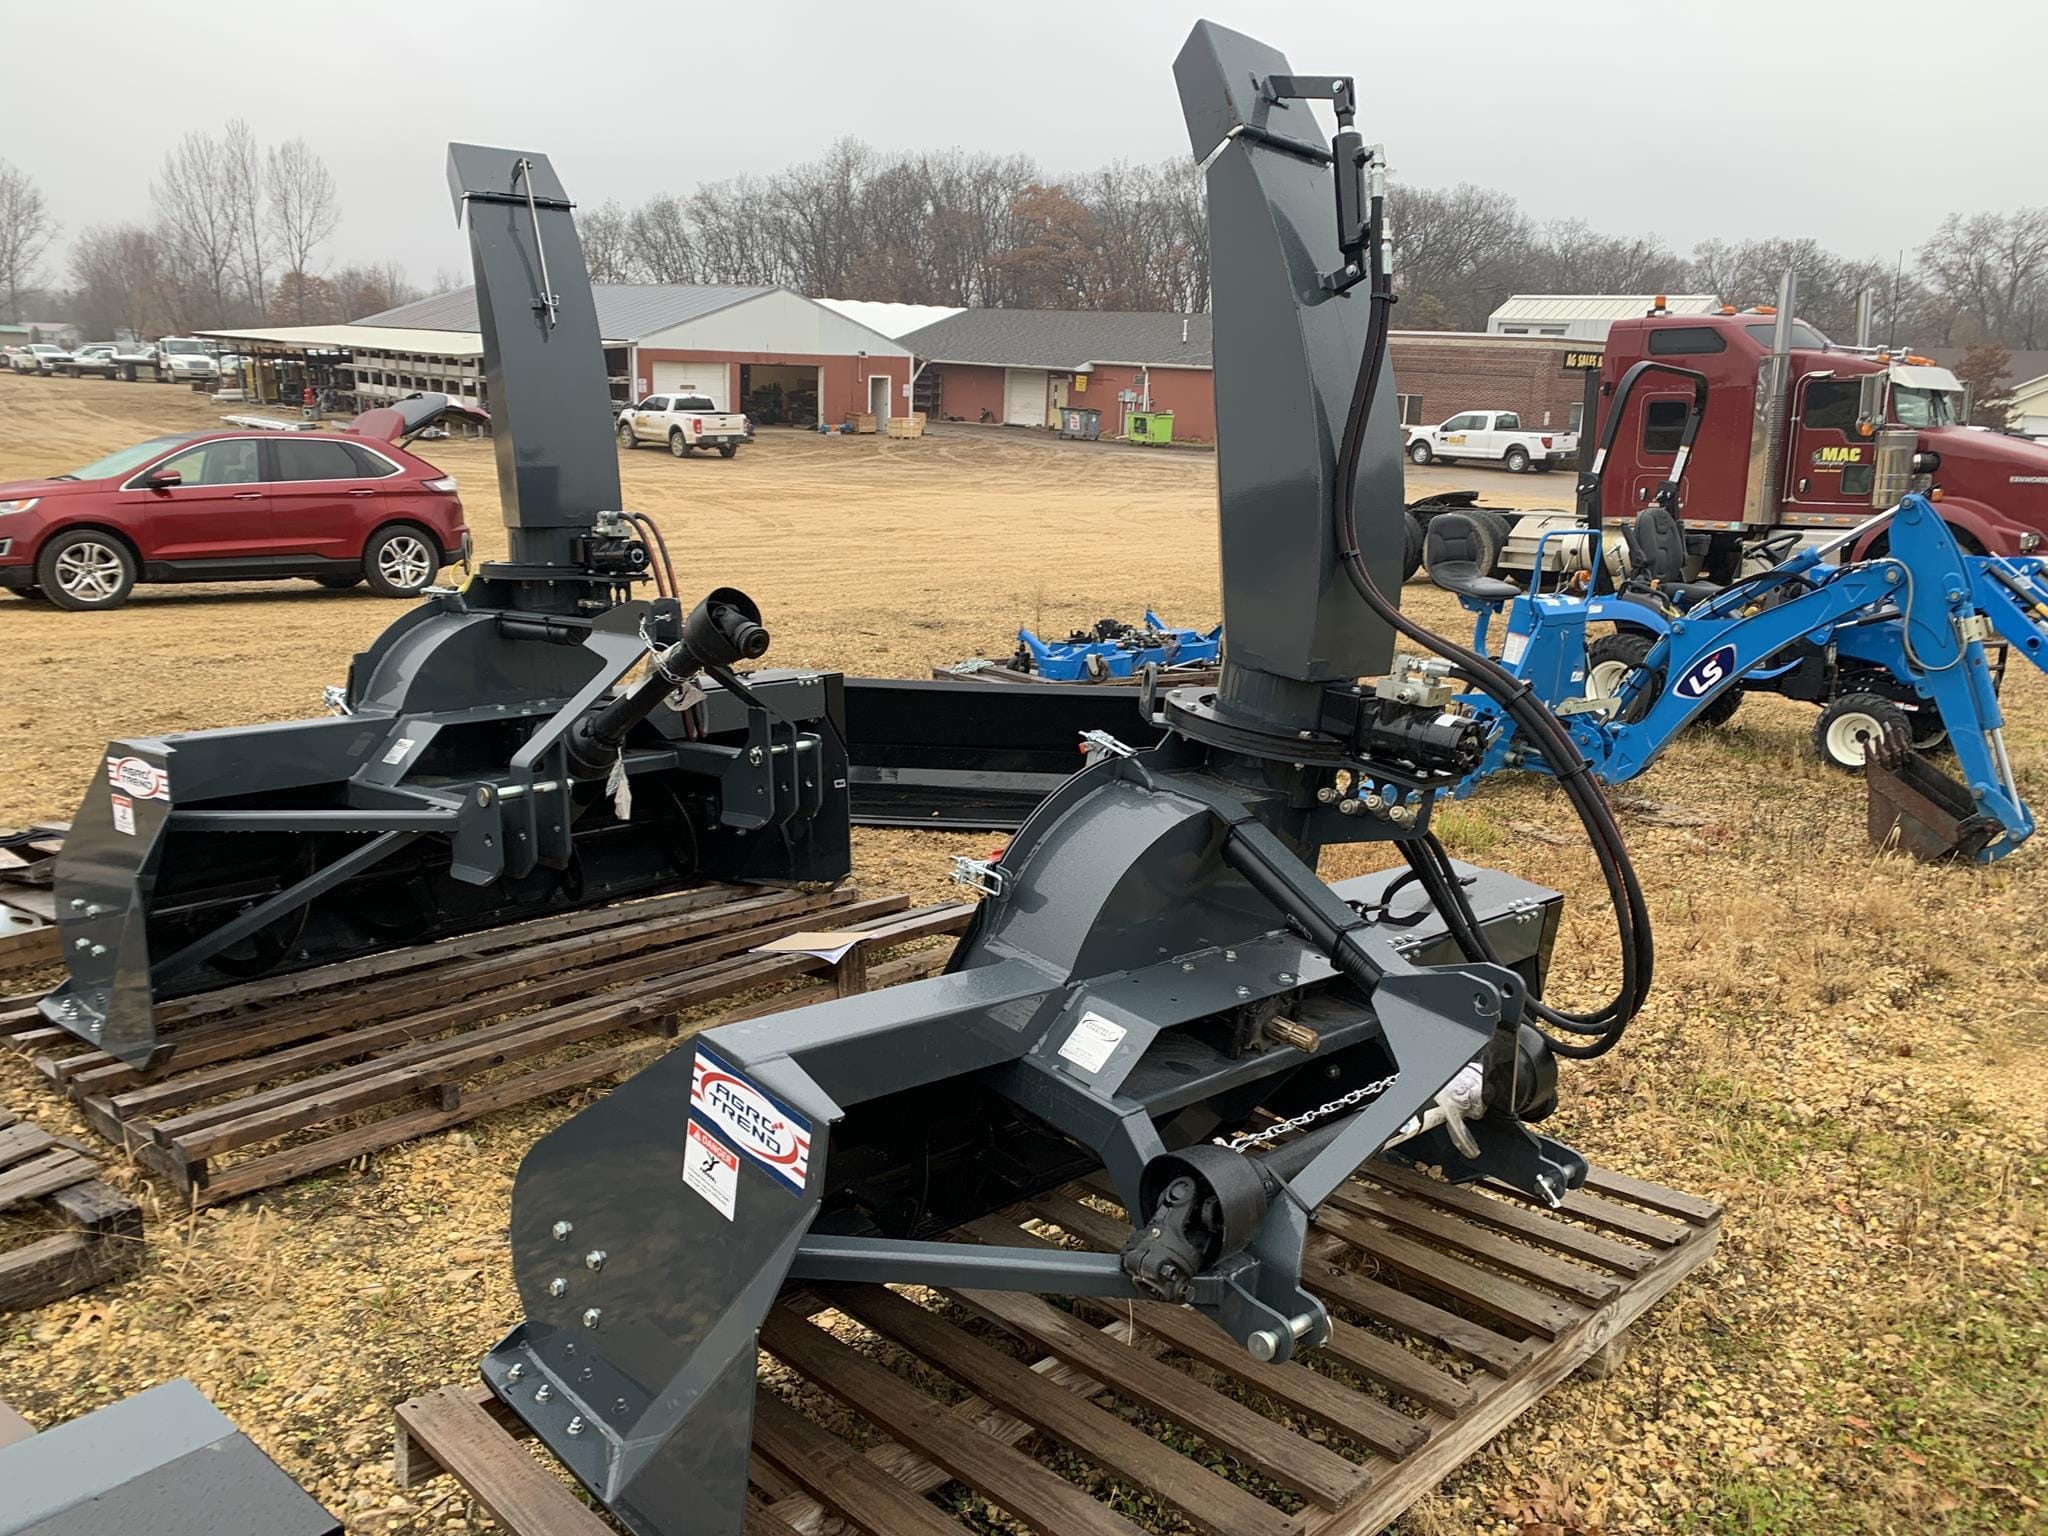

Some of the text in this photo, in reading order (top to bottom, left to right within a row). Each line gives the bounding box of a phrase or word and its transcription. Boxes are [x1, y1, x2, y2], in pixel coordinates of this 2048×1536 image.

[1566, 353, 1577, 367] AG
[1577, 354, 1596, 367] SALES
[1822, 447, 1861, 462] MAC
[1688, 660, 1723, 695] LS
[709, 1091, 781, 1155] TREND
[716, 1082, 781, 1135] AGRO
[702, 1135, 732, 1166] DANGER
